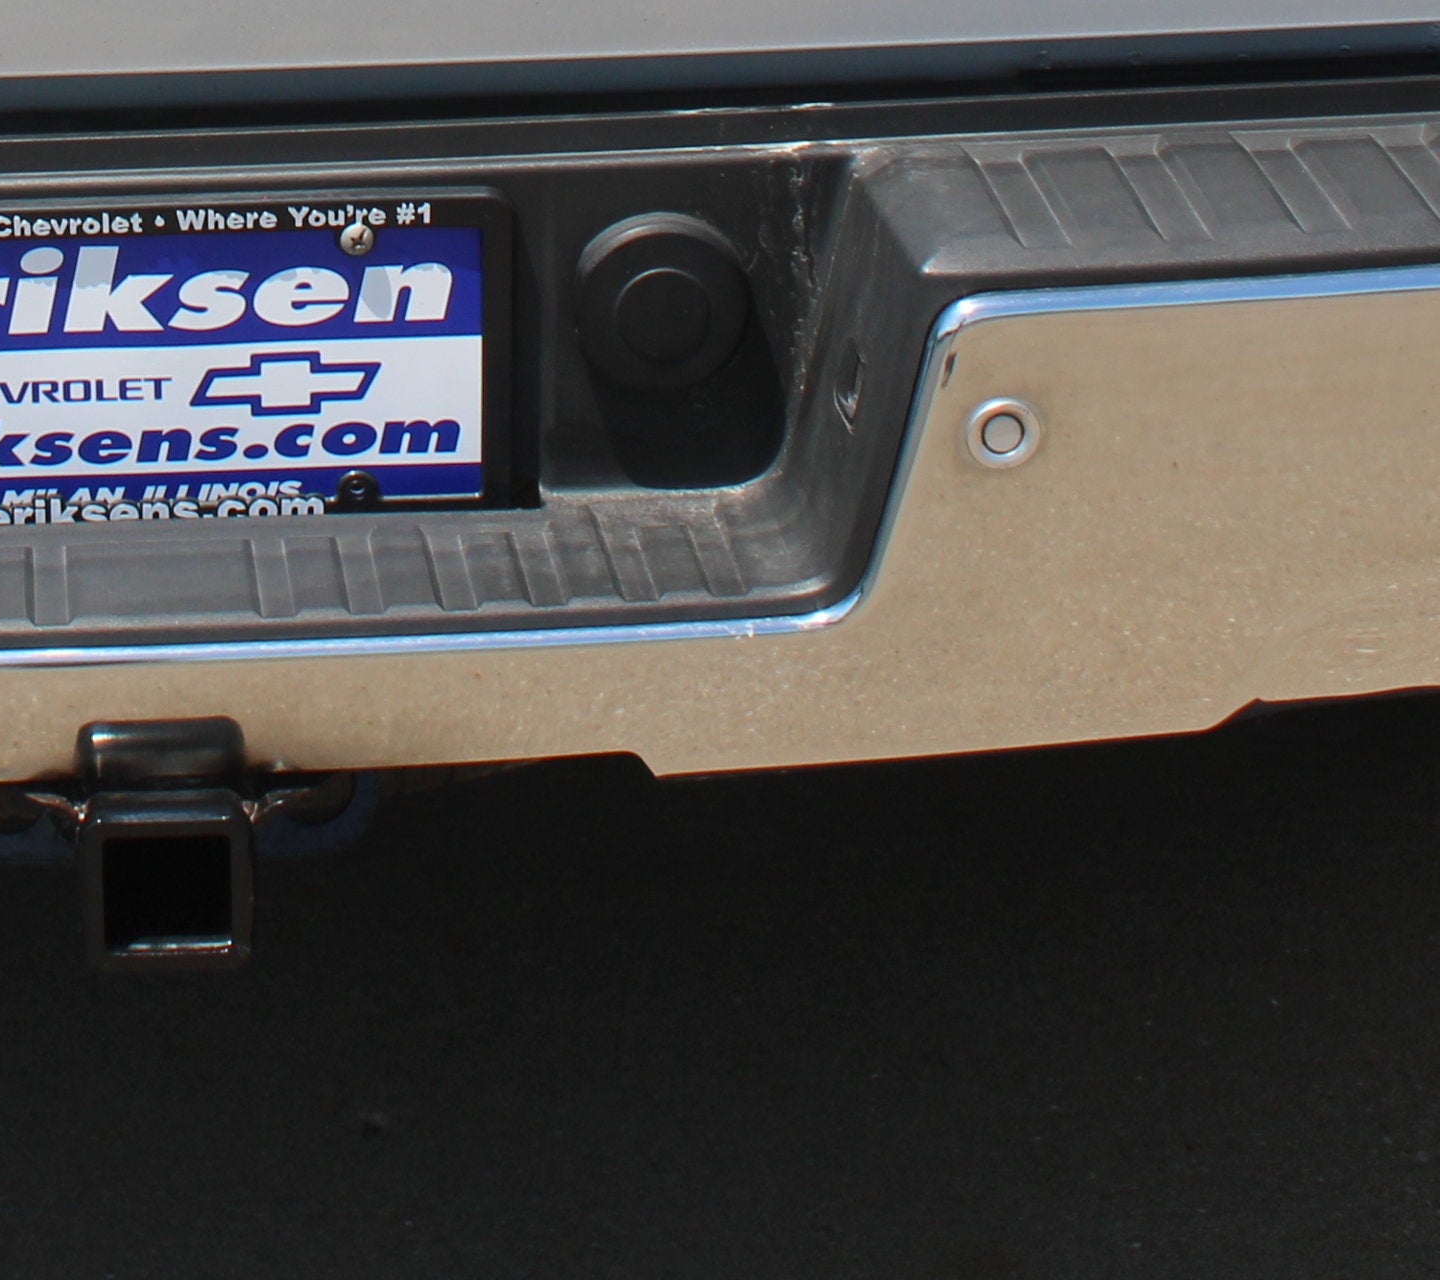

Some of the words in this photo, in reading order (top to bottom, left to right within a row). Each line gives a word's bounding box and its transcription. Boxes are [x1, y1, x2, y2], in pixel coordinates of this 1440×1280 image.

[176, 208, 279, 233] Where
[288, 204, 388, 227] You're
[395, 202, 435, 225] #1
